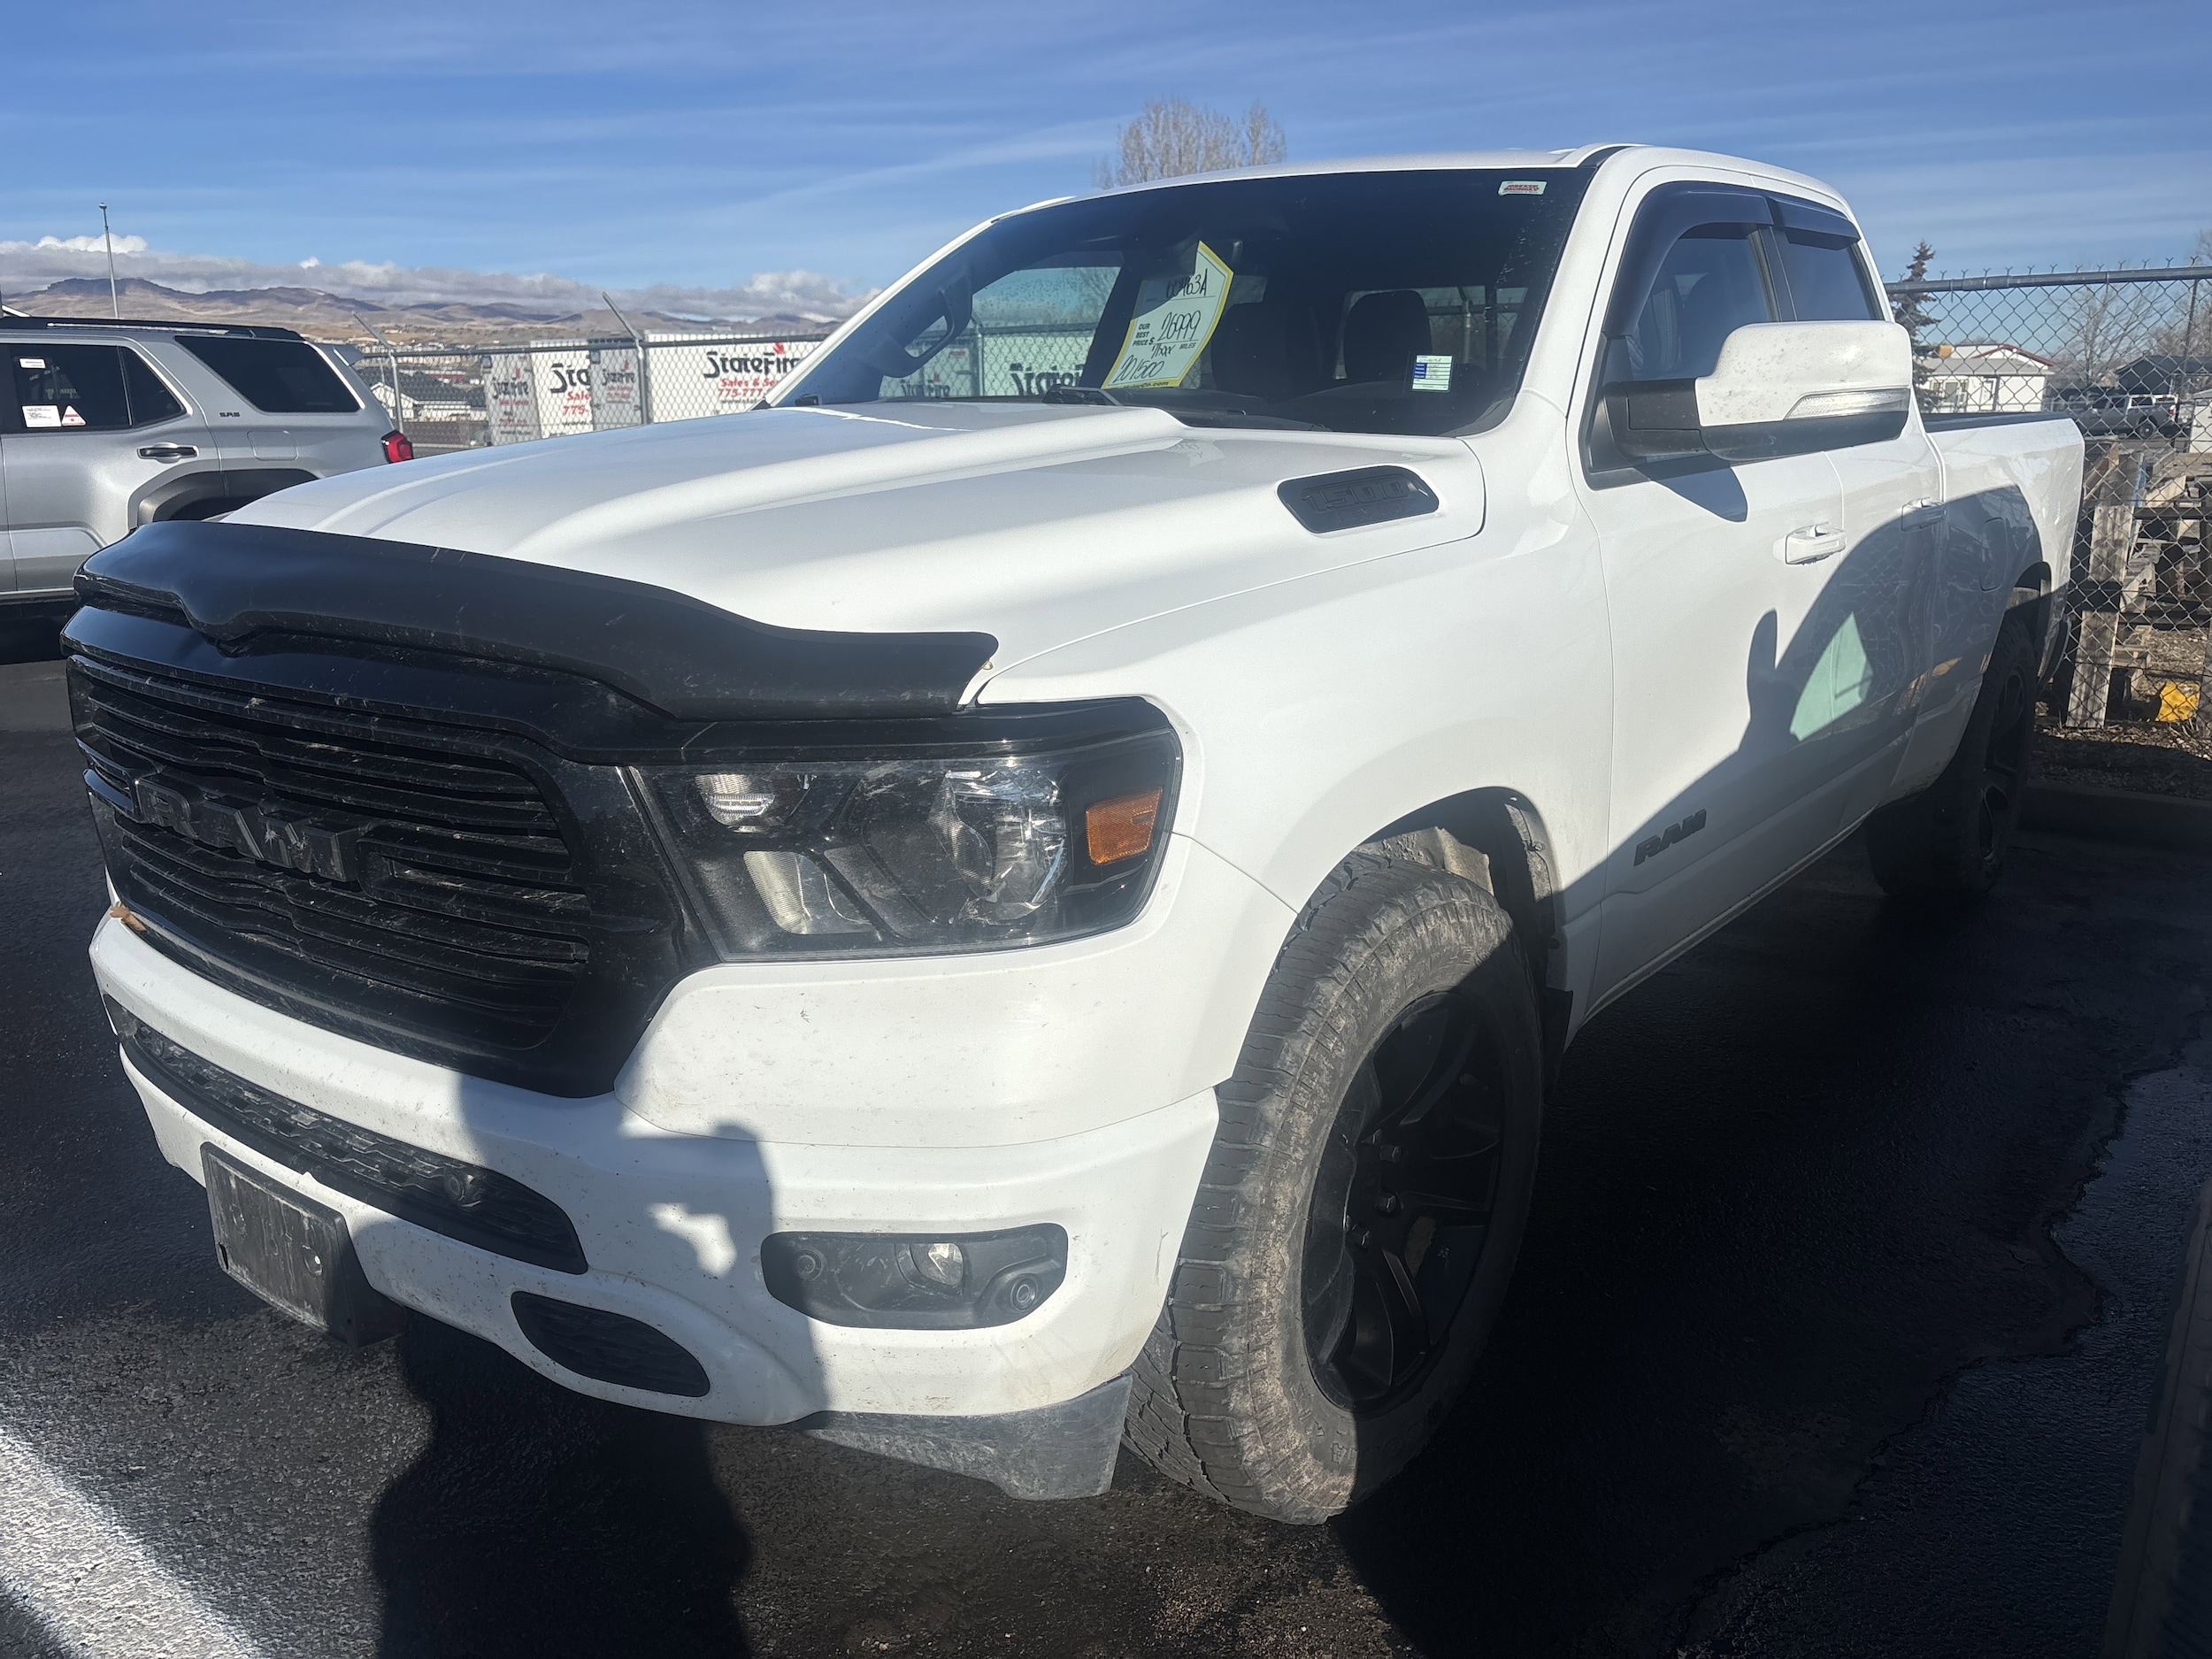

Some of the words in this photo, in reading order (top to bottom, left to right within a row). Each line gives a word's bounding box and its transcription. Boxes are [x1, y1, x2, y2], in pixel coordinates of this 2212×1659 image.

[721, 378, 749, 388] Sales
[752, 378, 761, 387] &
[1302, 479, 1410, 514] 1500
[132, 773, 356, 883] RAM
[1633, 808, 1708, 867] RAM
